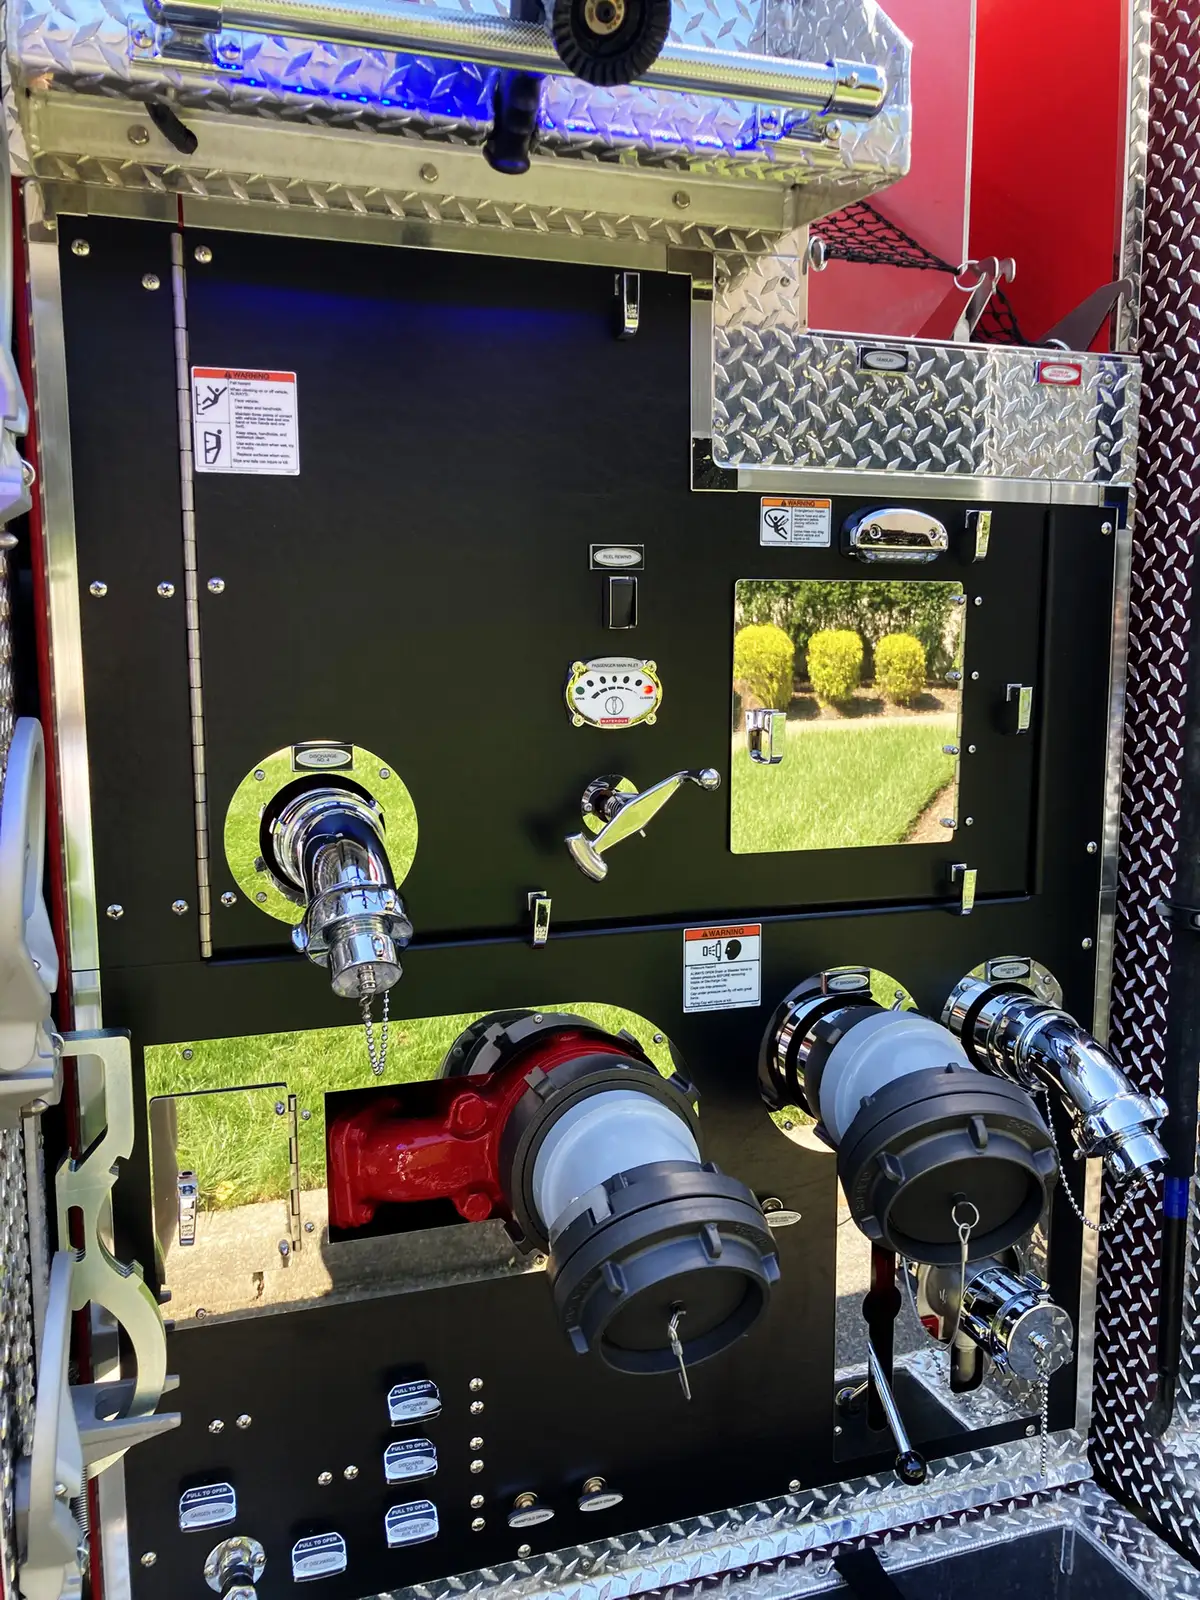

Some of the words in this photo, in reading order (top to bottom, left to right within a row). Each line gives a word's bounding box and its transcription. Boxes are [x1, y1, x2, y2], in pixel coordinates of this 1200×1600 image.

[233, 370, 270, 380] WARNING
[709, 928, 745, 937] WARNING
[402, 1400, 429, 1410] DISCHARGE
[398, 1460, 424, 1469] DISCHARGE
[322, 1536, 338, 1544] OPEN
